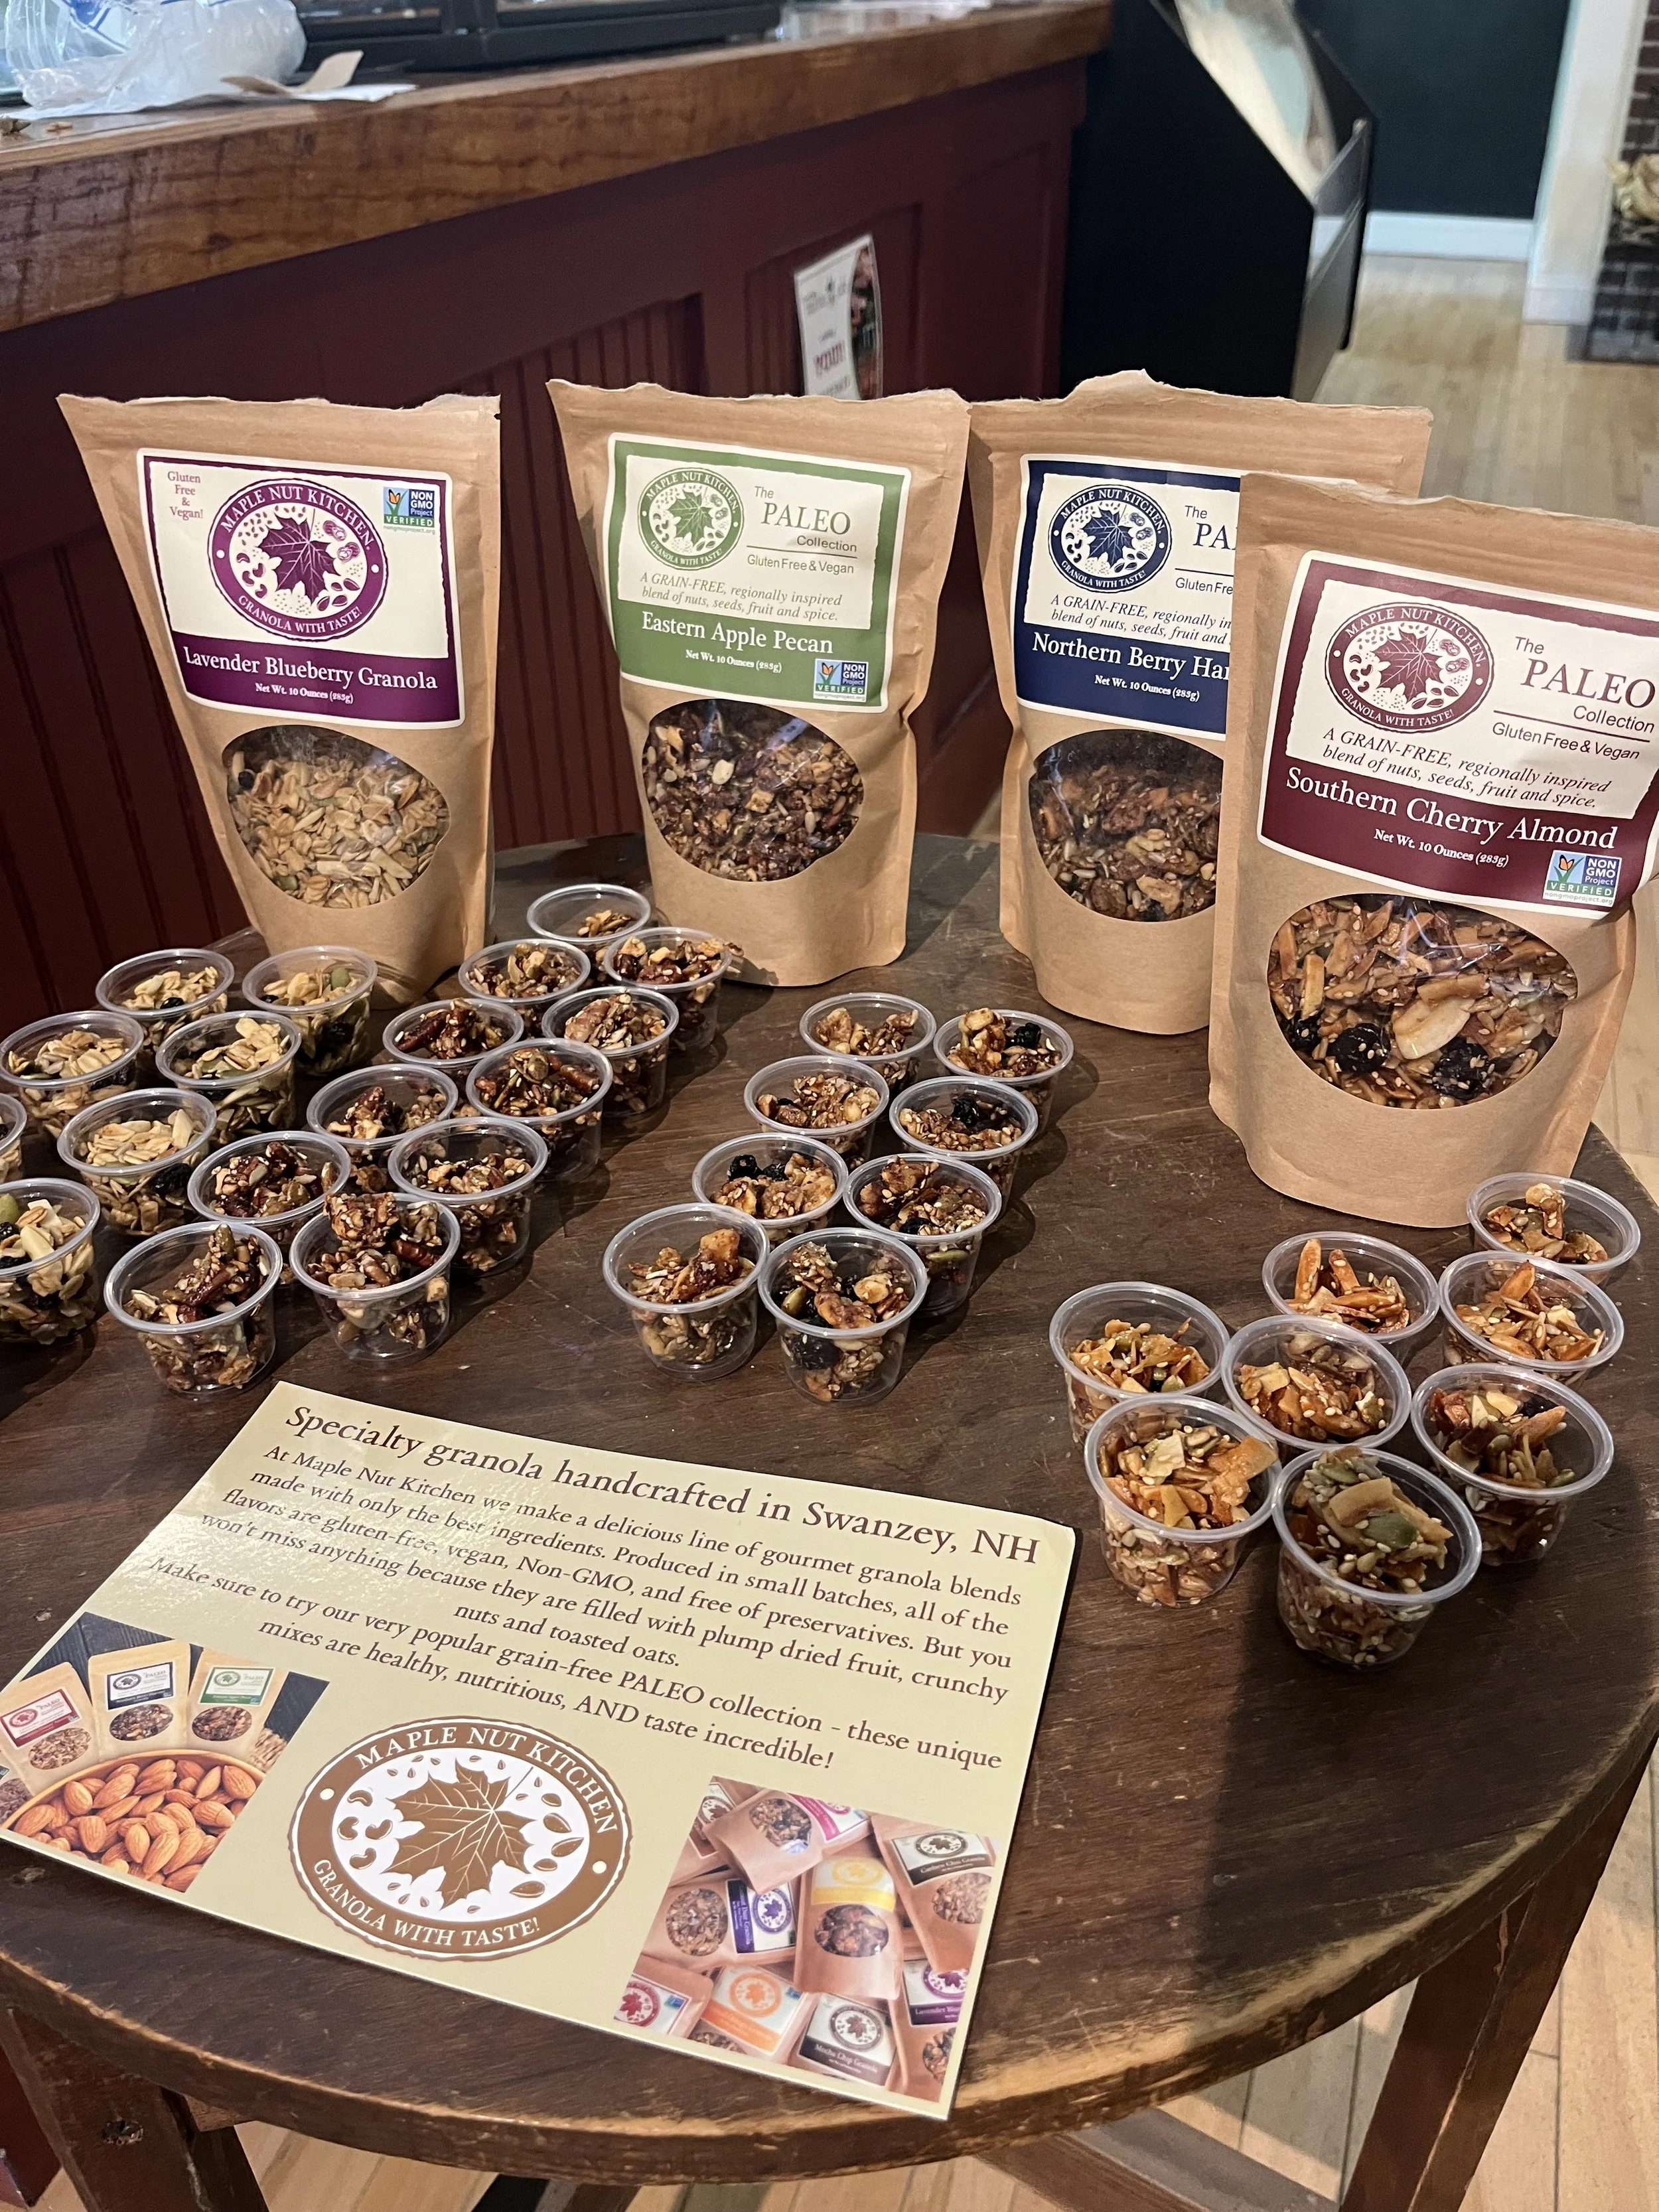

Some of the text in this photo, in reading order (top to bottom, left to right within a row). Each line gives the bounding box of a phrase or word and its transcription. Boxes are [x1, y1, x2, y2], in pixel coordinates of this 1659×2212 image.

[167, 471, 200, 483] Gluten
[175, 484, 196, 495] Free
[646, 474, 678, 500] MAPLE
[682, 472, 703, 481] NUT
[411, 491, 433, 500] NON
[411, 500, 433, 509] GMO
[755, 486, 774, 498] The
[1060, 491, 1095, 519] MAPLE
[1099, 489, 1122, 499] NUT
[169, 506, 203, 521] Vegan!
[220, 489, 265, 533] MAPLE
[268, 486, 303, 500] NUT
[386, 514, 433, 526] VERIFIED
[410, 508, 433, 516] Project
[761, 502, 851, 535] PALEO
[1185, 505, 1207, 519] The
[797, 536, 857, 552] Collection
[747, 554, 780, 567] Gluten
[782, 558, 807, 570] Free
[819, 561, 853, 575] Vegan
[1062, 560, 1092, 585] GRANOLA
[1119, 570, 1146, 586] TASTE!
[640, 572, 843, 607] A GRAIN-FREE, regionally inspired
[1176, 577, 1233, 595] Gluten Fre
[239, 595, 362, 633] GRANOLA WITH TASTE!
[642, 586, 837, 622] blend of nuts, seeds, fruit and spice.
[642, 611, 833, 653] Eastern Apple Pecan
[1345, 609, 1395, 638] MAPLE
[1400, 608, 1433, 621] NUT
[685, 649, 699, 660] Net
[700, 652, 715, 662] Wt.
[727, 656, 755, 668] Ounces
[1033, 632, 1121, 664] Northern
[1127, 646, 1187, 680] Berry
[1516, 636, 1544, 654] The
[183, 646, 438, 690] Lavender Blueberry Granola
[842, 678, 864, 686] Project
[255, 683, 270, 692] Net
[271, 684, 287, 694] Wt.
[299, 688, 328, 699] Ounces
[818, 684, 863, 694] VERIFIED
[1094, 675, 1110, 686] Net
[1112, 678, 1127, 688] Wt.
[1141, 682, 1171, 695] Ounces
[1520, 658, 1656, 708] PALEO
[1342, 688, 1454, 726] GRANOLA WITH TASTE!
[1574, 705, 1654, 733] Collection
[1492, 722, 1542, 743] Gluten
[1544, 732, 1578, 751] Free
[1596, 742, 1640, 761] Vegan
[1323, 727, 1612, 792] A GRAIN-FREE, regionally inspired
[1323, 745, 1595, 808] blend of nuts, seeds, fruit and spice.
[1287, 767, 1618, 849] Southern Cherry Almond
[1374, 829, 1394, 843] Net
[1397, 834, 1415, 848] Wt.
[1418, 842, 1431, 852] 10
[1433, 844, 1474, 861] Ounces
[1586, 867, 1615, 878] GMO
[1588, 858, 1617, 869] NON
[1551, 879, 1613, 896] VERIFIED
[1585, 875, 1613, 885] Project
[285, 1407, 1040, 1564] Specialty granola handcrafted in Swanzey, NH
[263, 1446, 1021, 1605] At Maple Nut Kitchen we make a delicious line of gourmet granola blends
[453, 1607, 679, 1666] nuts and toasted oats.
[258, 1622, 833, 1769] mixes are healthy, nutritious, AND taste incredible!
[355, 1727, 617, 1833] MAPLE NUT KITCHEN
[315, 1860, 540, 1947] GRANOLA WITH TASTE!
